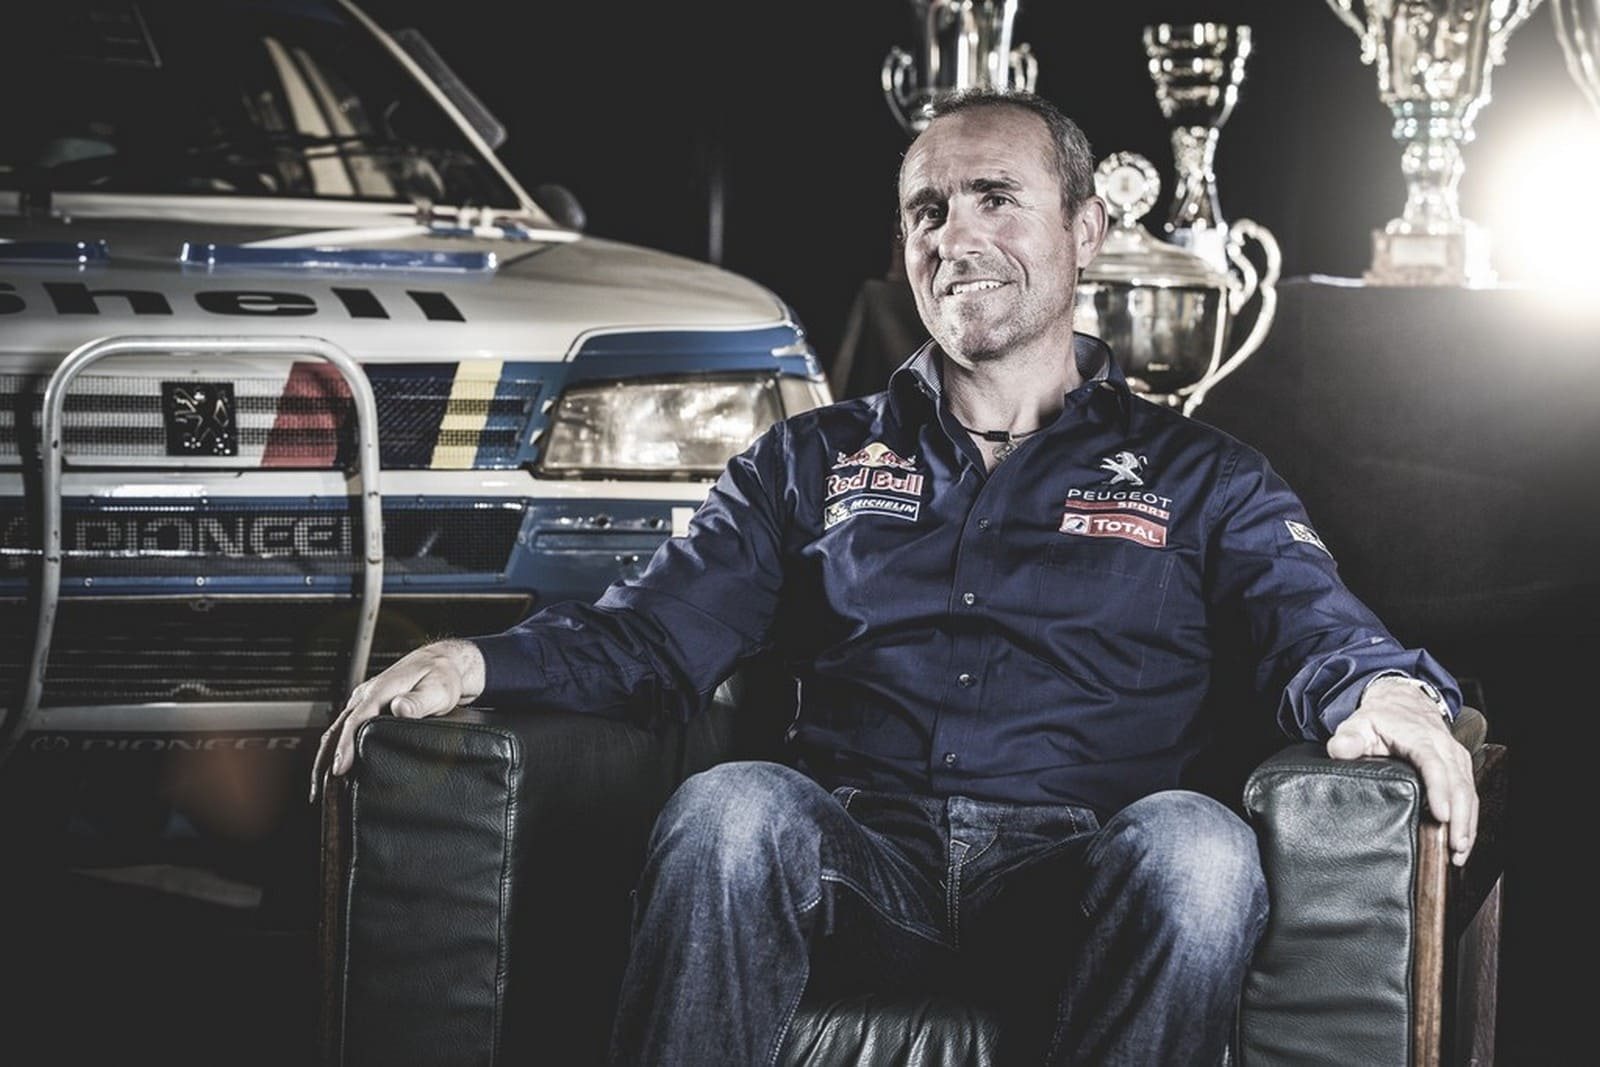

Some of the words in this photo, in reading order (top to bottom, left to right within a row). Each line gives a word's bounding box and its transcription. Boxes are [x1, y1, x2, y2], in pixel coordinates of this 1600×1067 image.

[0, 282, 466, 322] hell
[825, 467, 869, 500] Red
[870, 470, 924, 496] Bull
[850, 499, 916, 513] MICHELIN
[1067, 488, 1172, 508] PEUGEOT
[1117, 501, 1168, 519] SPORT
[75, 516, 352, 556] PIONEE
[1093, 519, 1160, 543] TOTAL
[81, 736, 301, 751] PIONEER
